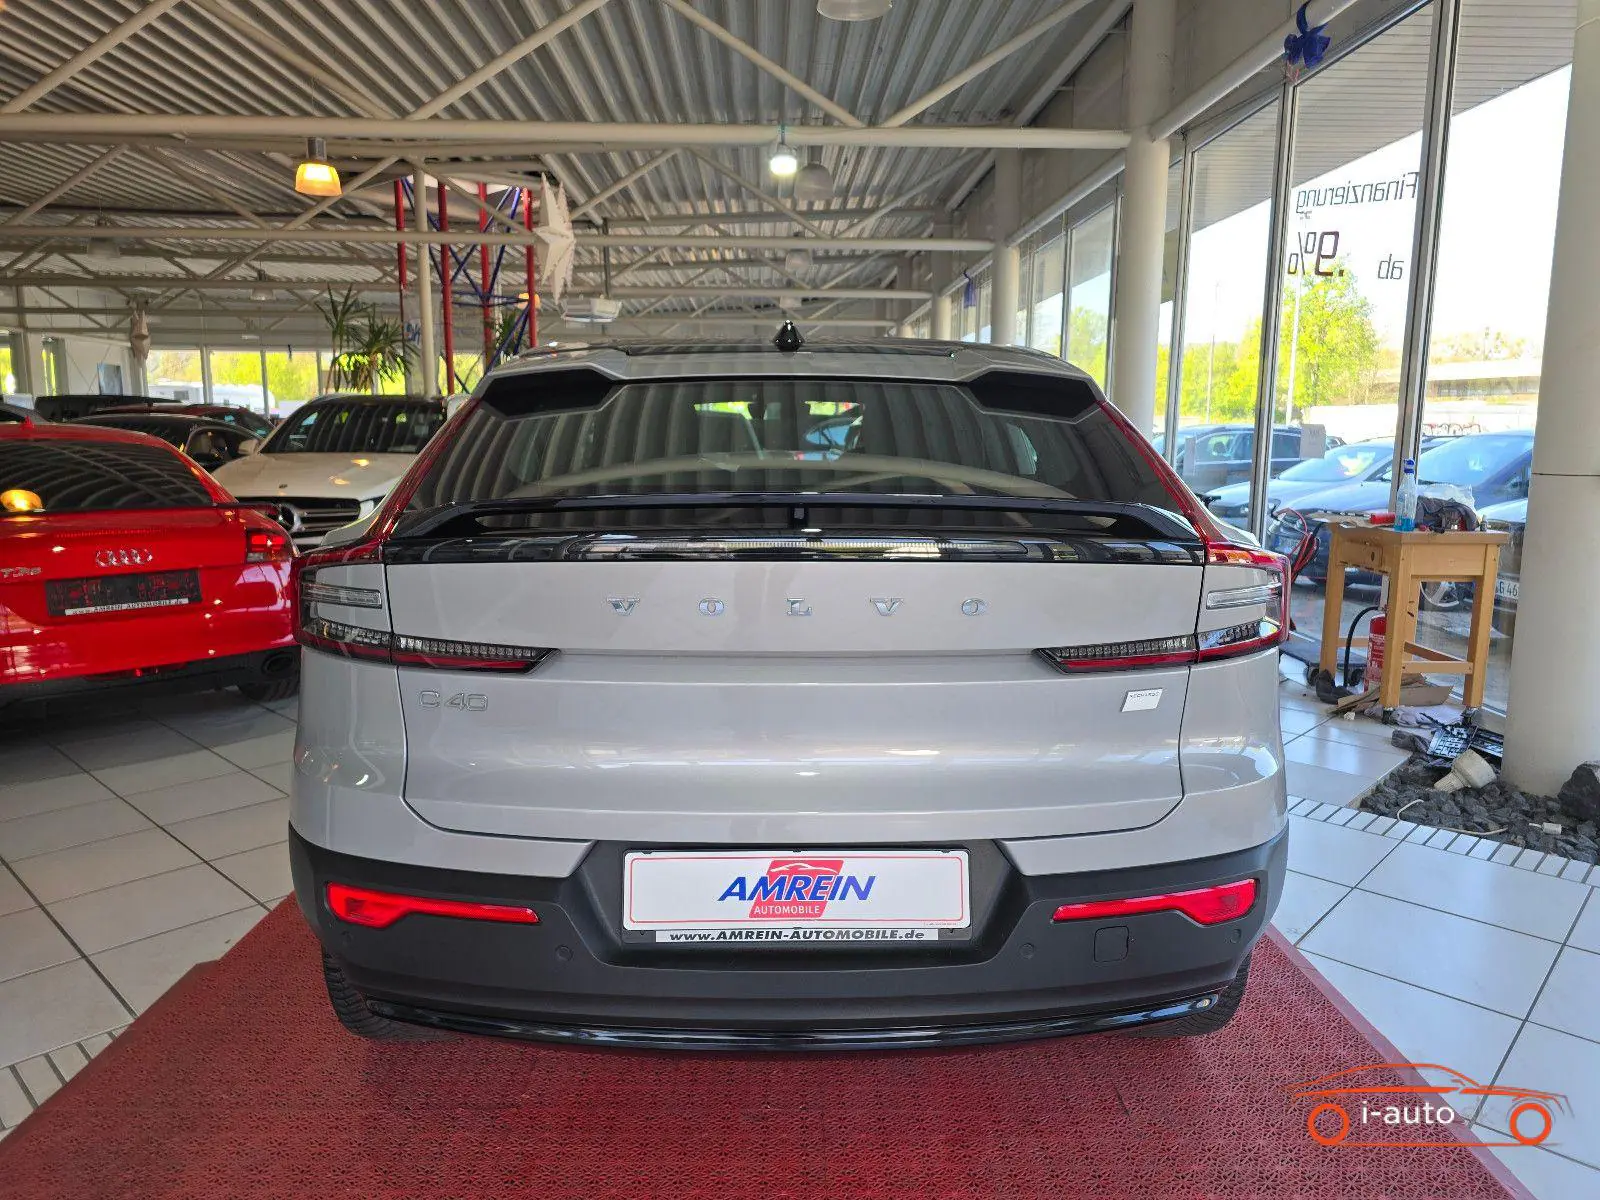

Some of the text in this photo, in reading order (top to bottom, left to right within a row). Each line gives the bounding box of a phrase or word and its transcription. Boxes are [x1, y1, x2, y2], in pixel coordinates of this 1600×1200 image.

[606, 597, 988, 617] VOLVO
[717, 874, 876, 902] AMREIN
[753, 905, 820, 915] AUTOMOBILE
[669, 929, 925, 941] www.AMREIN-AUTOMOBILE.de
